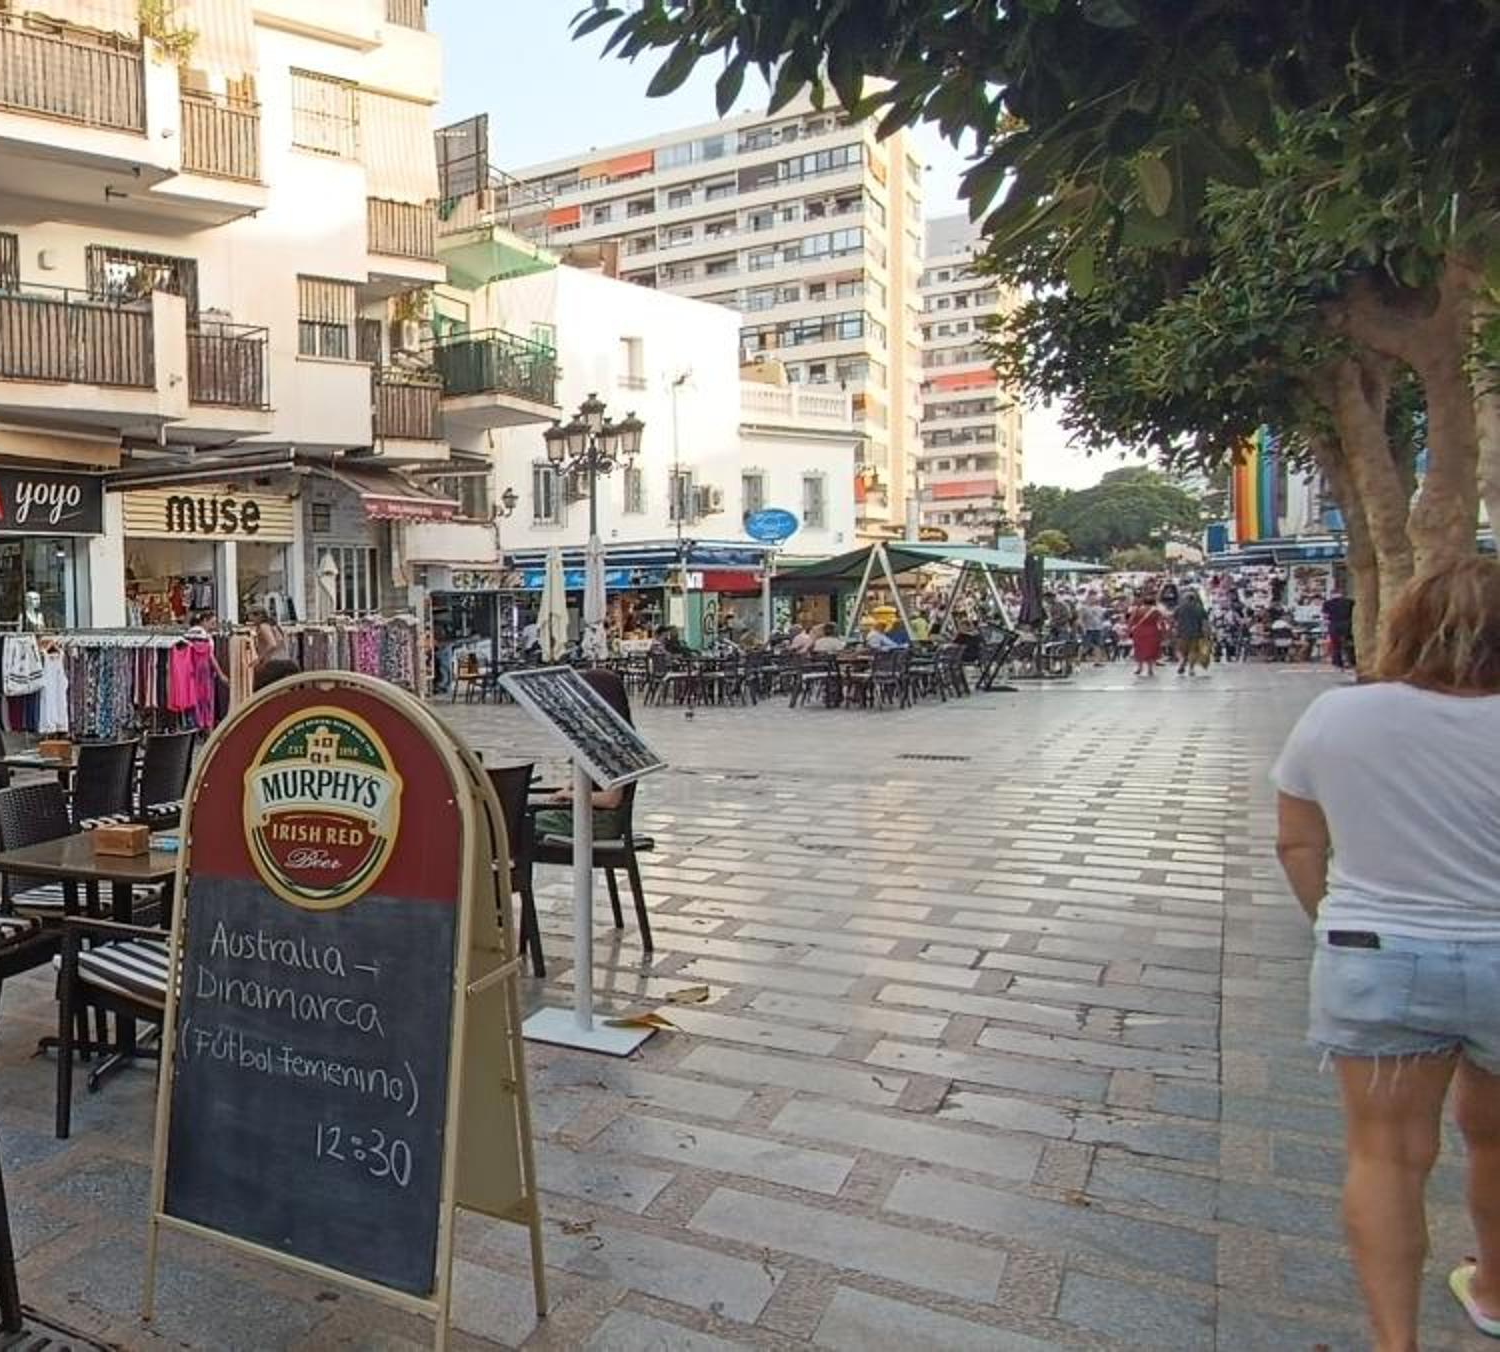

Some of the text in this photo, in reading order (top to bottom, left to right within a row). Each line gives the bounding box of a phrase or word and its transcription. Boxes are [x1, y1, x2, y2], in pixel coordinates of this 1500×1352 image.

[15, 481, 81, 524] yoyo
[165, 495, 260, 534] muse
[261, 769, 381, 809] MURPHY'S
[272, 823, 363, 846] IRISH RED
[210, 921, 345, 976] Australia
[196, 964, 385, 1037] Dinamarca
[315, 1122, 412, 1187] 12:30
